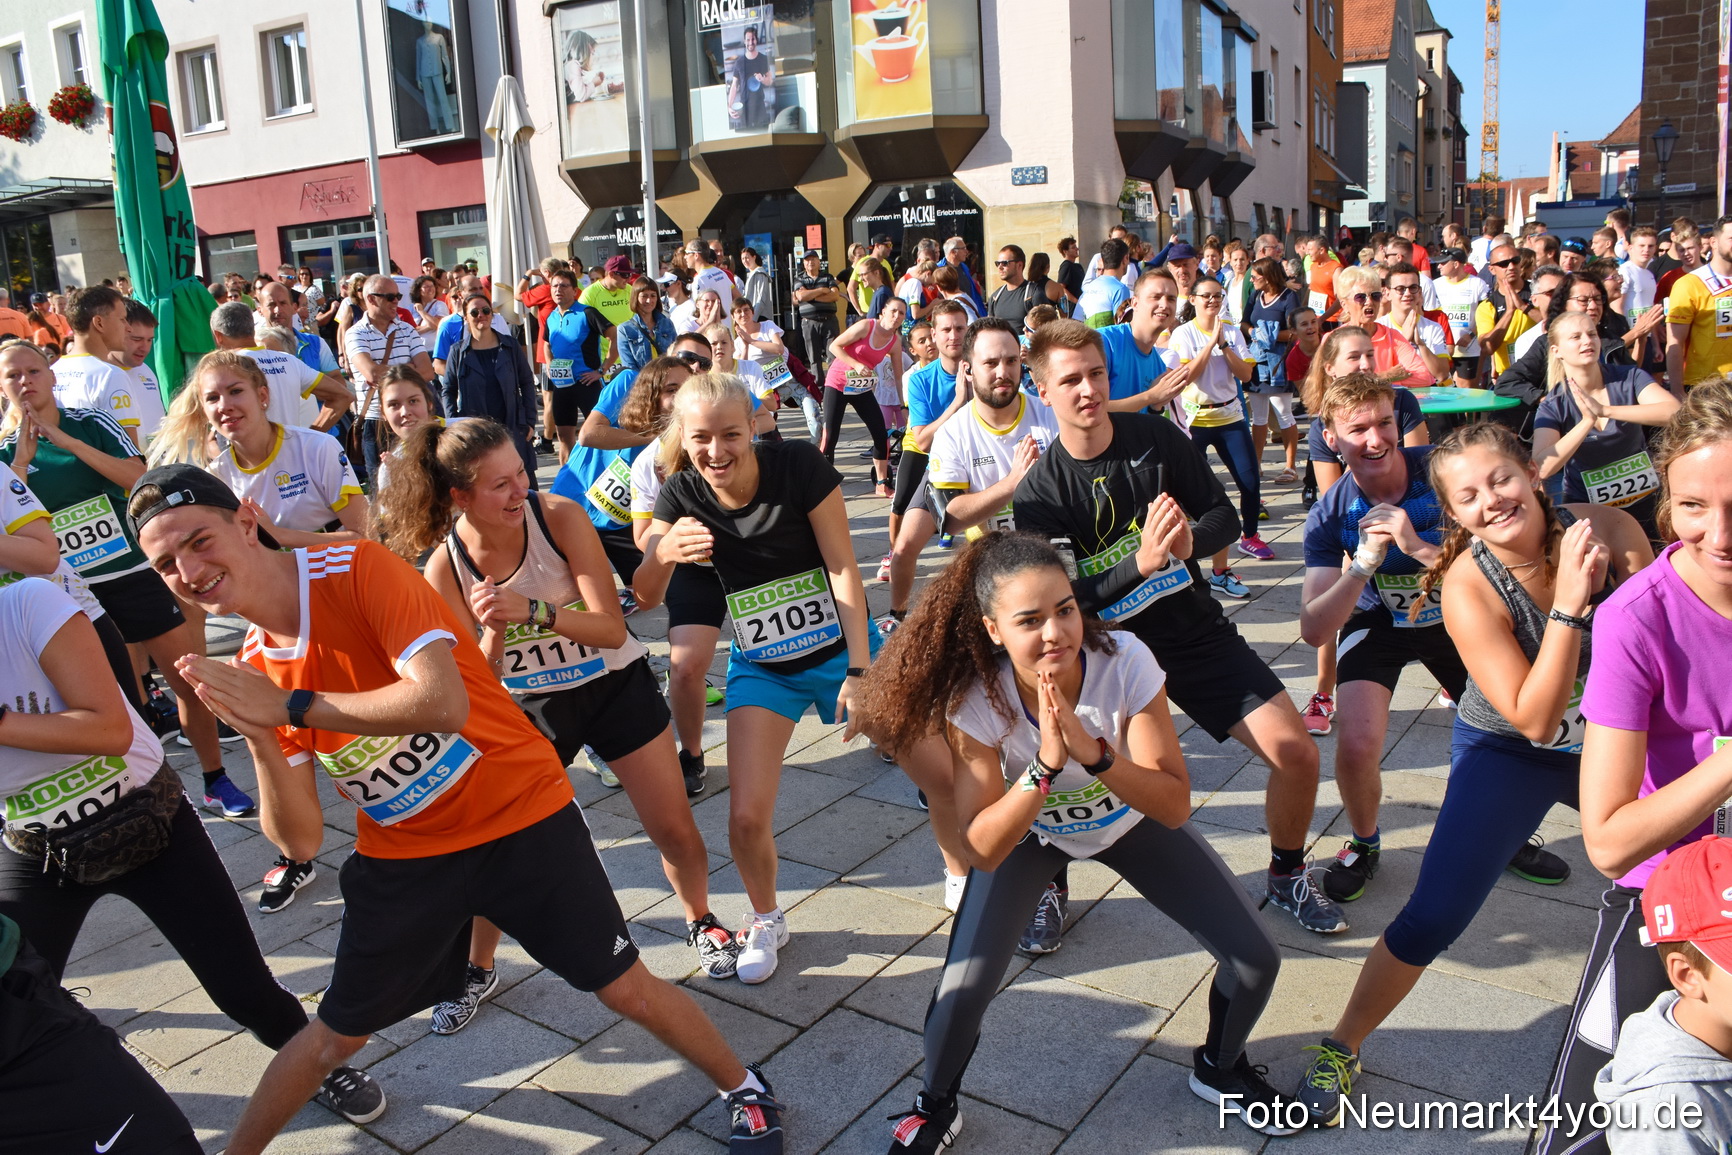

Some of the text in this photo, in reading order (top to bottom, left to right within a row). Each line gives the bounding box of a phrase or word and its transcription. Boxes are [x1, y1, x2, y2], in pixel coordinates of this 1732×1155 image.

[850, 378, 876, 388] 2221
[112, 395, 131, 410] 20
[275, 474, 290, 486] 20
[1588, 456, 1647, 485] BOCK
[1596, 473, 1651, 503] 5222
[1611, 496, 1638, 507] ANJA
[593, 491, 631, 522] MATTHIAS
[73, 547, 108, 566] JULIA
[1082, 536, 1141, 578] BOC
[734, 572, 822, 615] BOCK
[1110, 575, 1178, 615] VALENTIN
[746, 600, 825, 645] 2103
[504, 640, 587, 673] 2111
[758, 631, 829, 659] JOHANNA
[526, 668, 584, 687] CELINA
[345, 732, 441, 802] 2109
[15, 757, 119, 817] BOCK
[387, 764, 451, 813] NIKLAS
